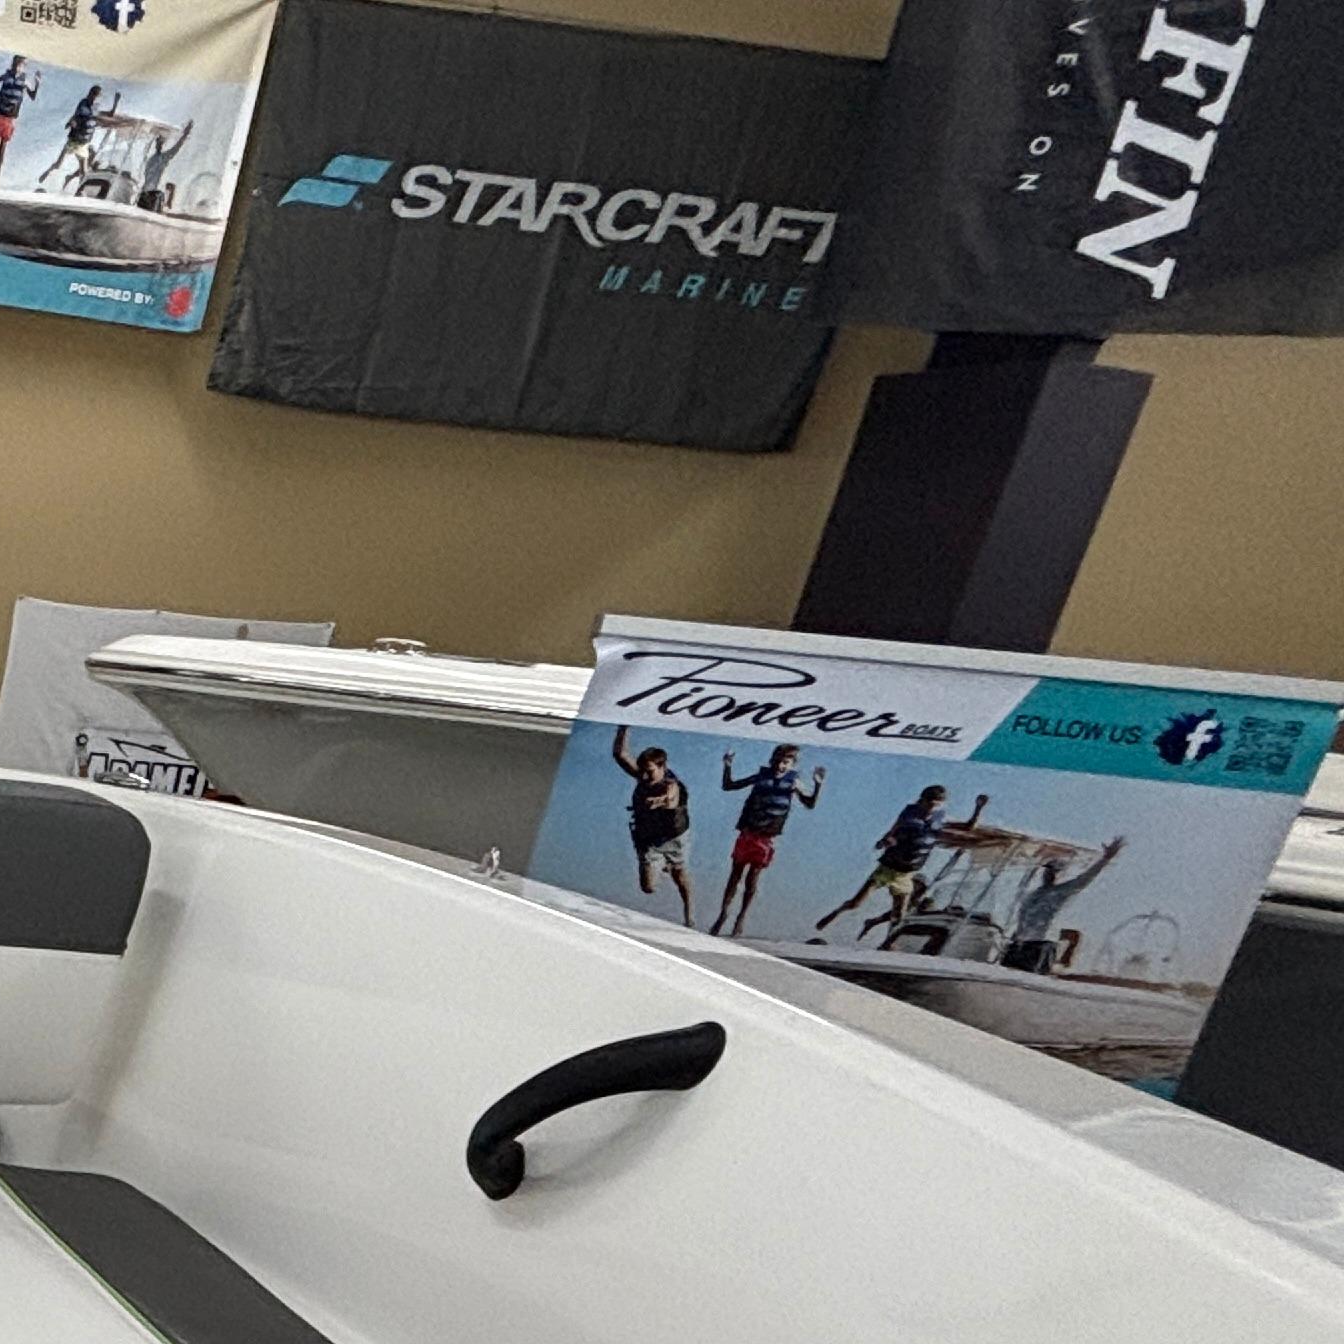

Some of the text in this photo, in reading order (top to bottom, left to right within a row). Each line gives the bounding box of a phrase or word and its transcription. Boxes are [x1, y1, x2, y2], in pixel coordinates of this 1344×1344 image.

[1017, 0, 1093, 191] VES ON
[1076, 0, 1263, 299] FIN
[390, 164, 838, 263] STARCRAFT
[69, 282, 131, 302] POWERED
[599, 265, 810, 311] MARINE
[616, 651, 962, 738] Pioneer BOATS
[1013, 714, 1142, 745] FOLLOW US
